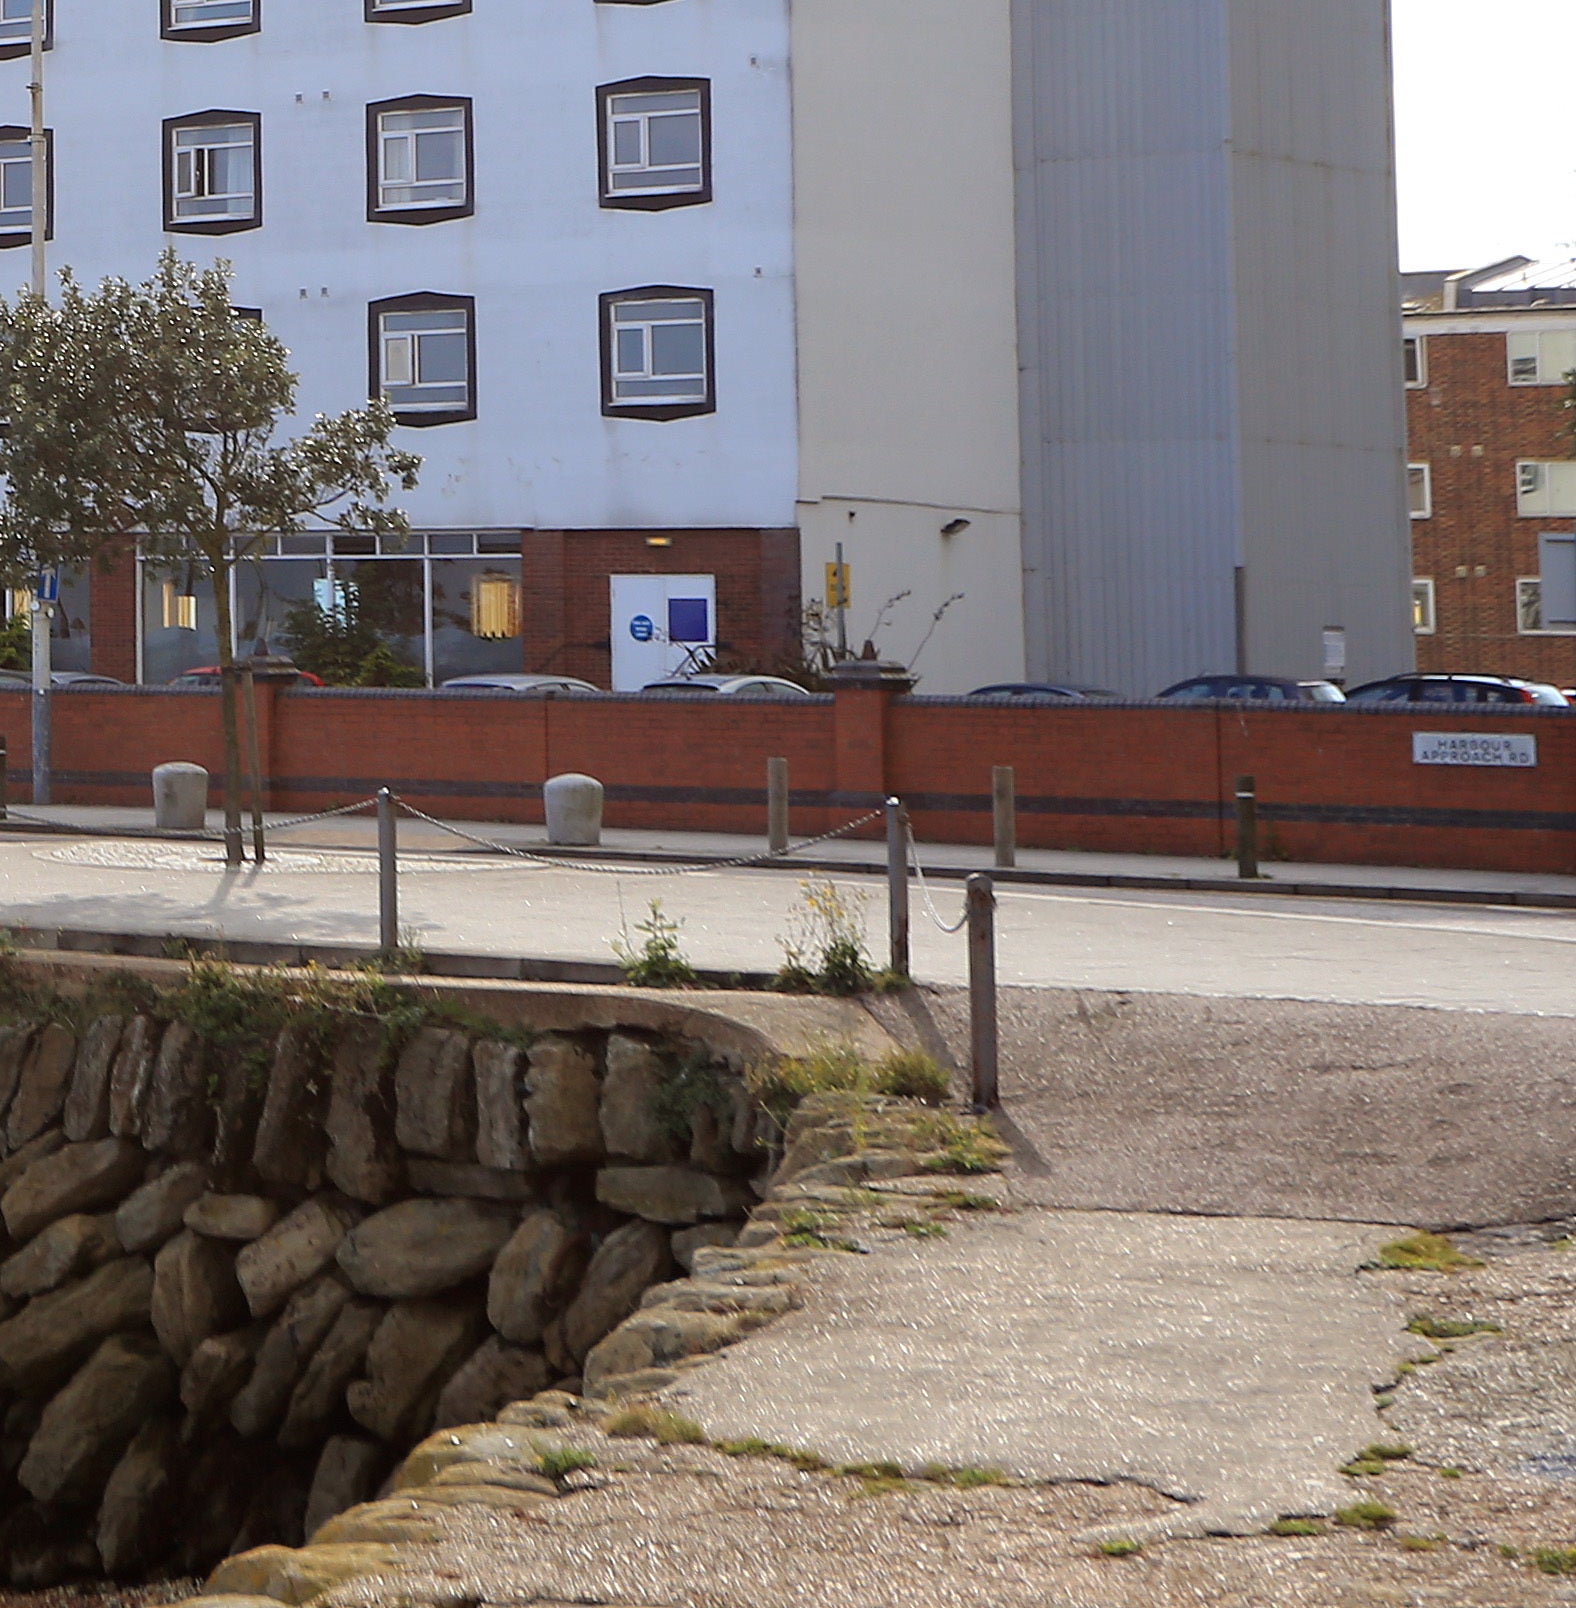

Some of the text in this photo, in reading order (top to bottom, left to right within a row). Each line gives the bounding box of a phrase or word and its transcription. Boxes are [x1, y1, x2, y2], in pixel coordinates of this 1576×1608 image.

[1437, 739, 1511, 751] HARBOUR
[1422, 750, 1529, 764] APPROACH RD
